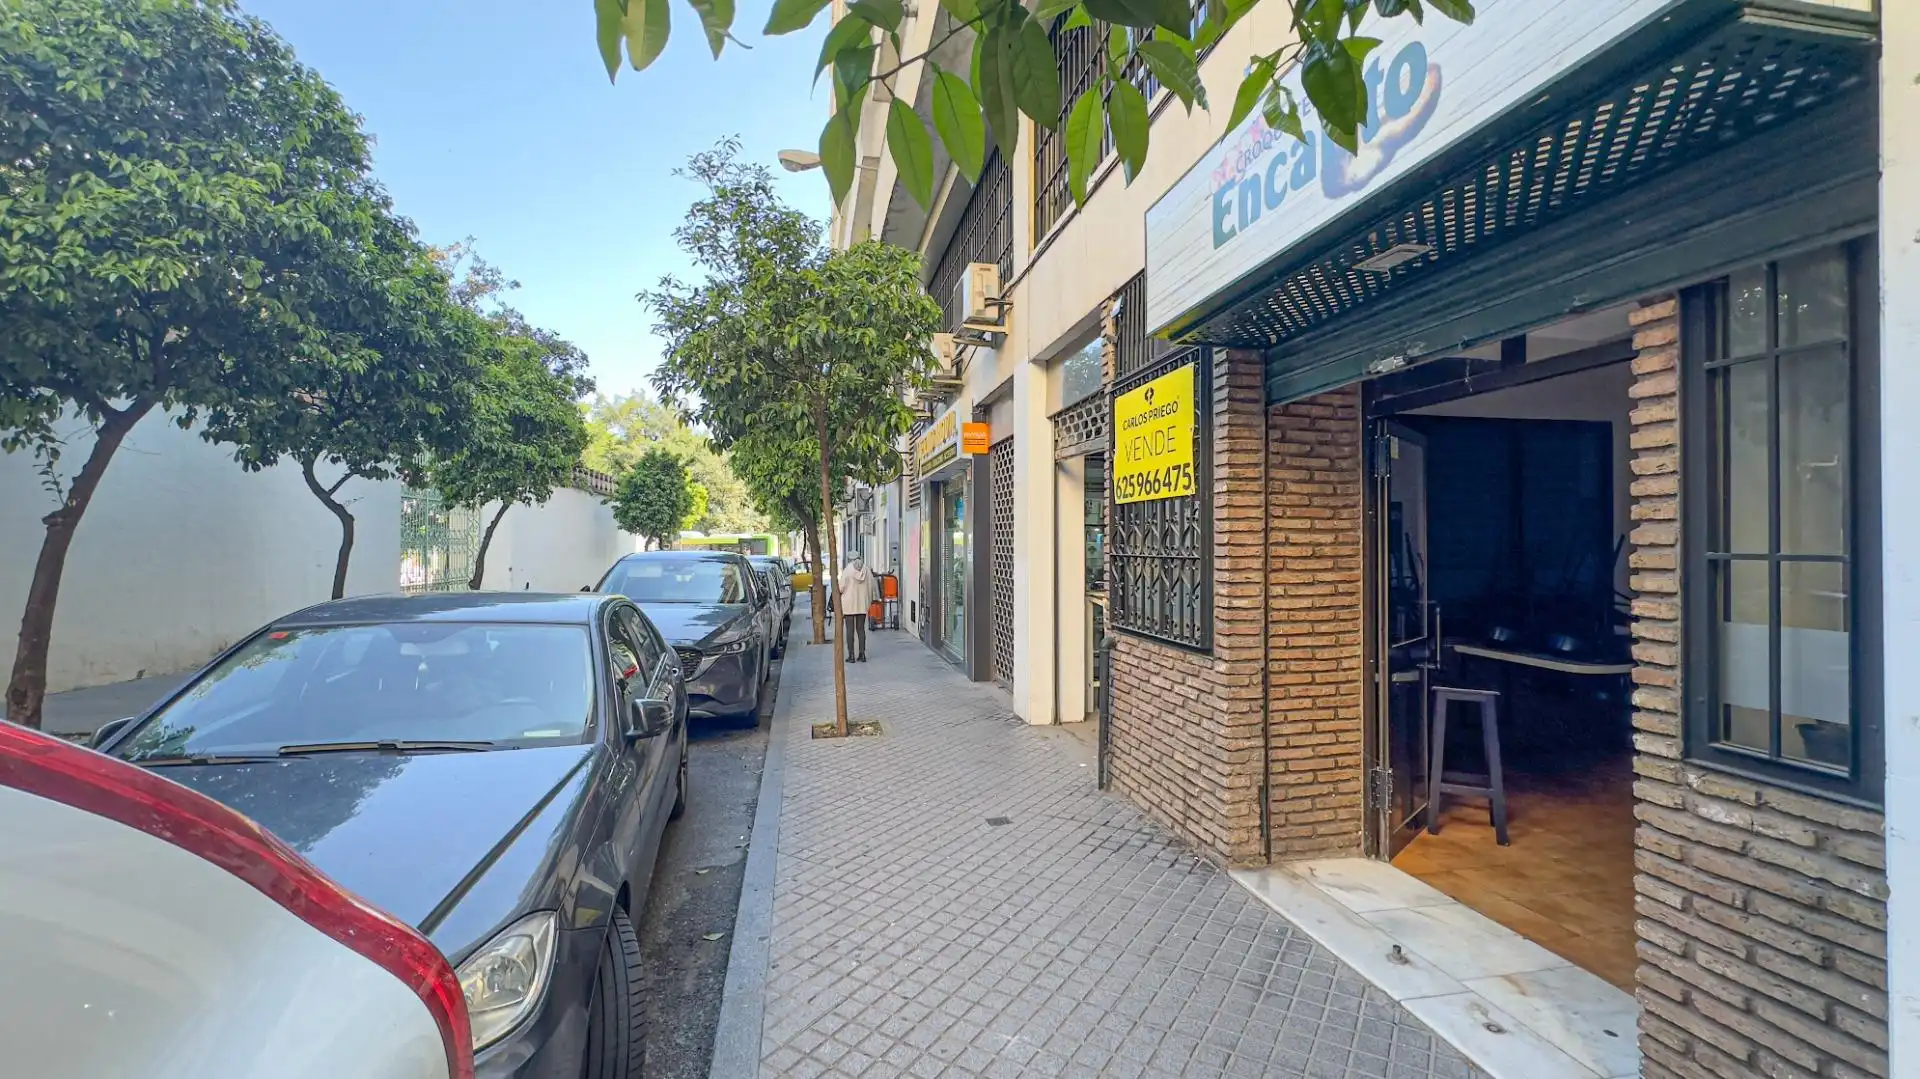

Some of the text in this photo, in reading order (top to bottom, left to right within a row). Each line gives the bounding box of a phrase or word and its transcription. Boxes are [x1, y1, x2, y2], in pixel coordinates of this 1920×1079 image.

[1122, 400, 1179, 431] CARLOS PRIEGO
[1124, 425, 1177, 463] VENDE
